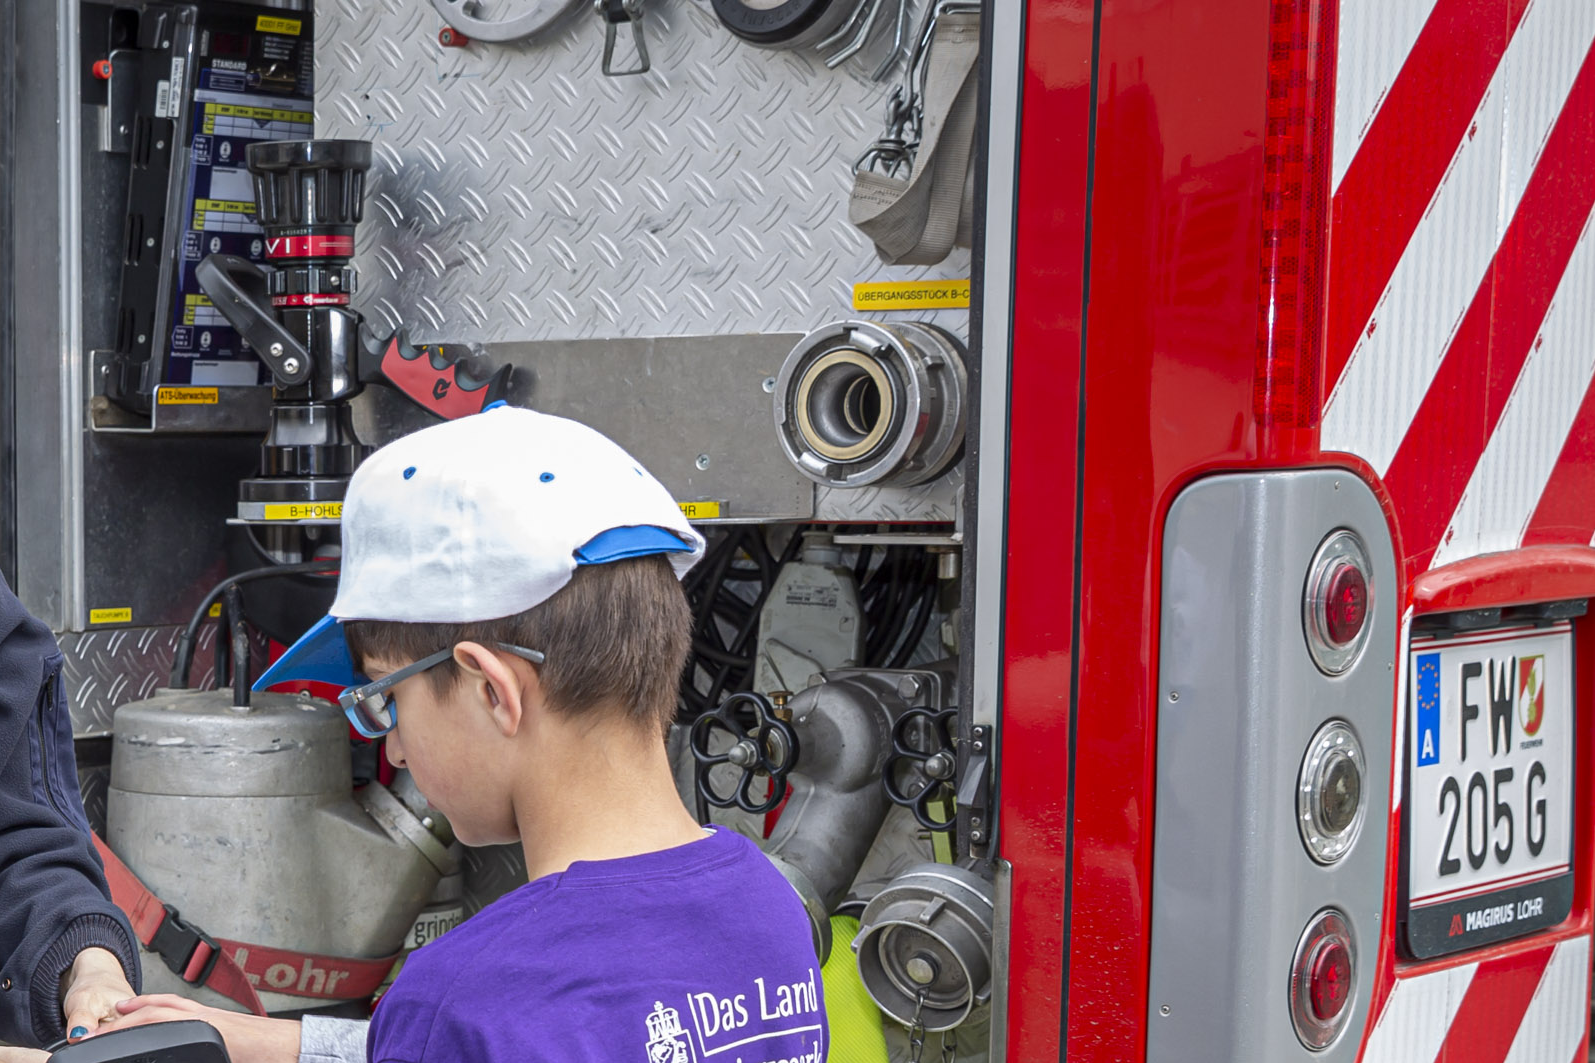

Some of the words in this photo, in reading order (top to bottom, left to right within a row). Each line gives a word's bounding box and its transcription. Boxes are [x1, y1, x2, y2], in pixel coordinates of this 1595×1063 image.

[212, 58, 248, 71] STANDARD
[1459, 655, 1516, 765] FW
[1421, 729, 1435, 759] A
[1437, 766, 1514, 878] 205
[1525, 760, 1547, 858] G
[1466, 903, 1514, 931] MAGIRUS
[1517, 897, 1544, 920] LOHR
[234, 947, 350, 994] Lohr
[694, 992, 748, 1037] Das
[754, 968, 818, 1020] Land
